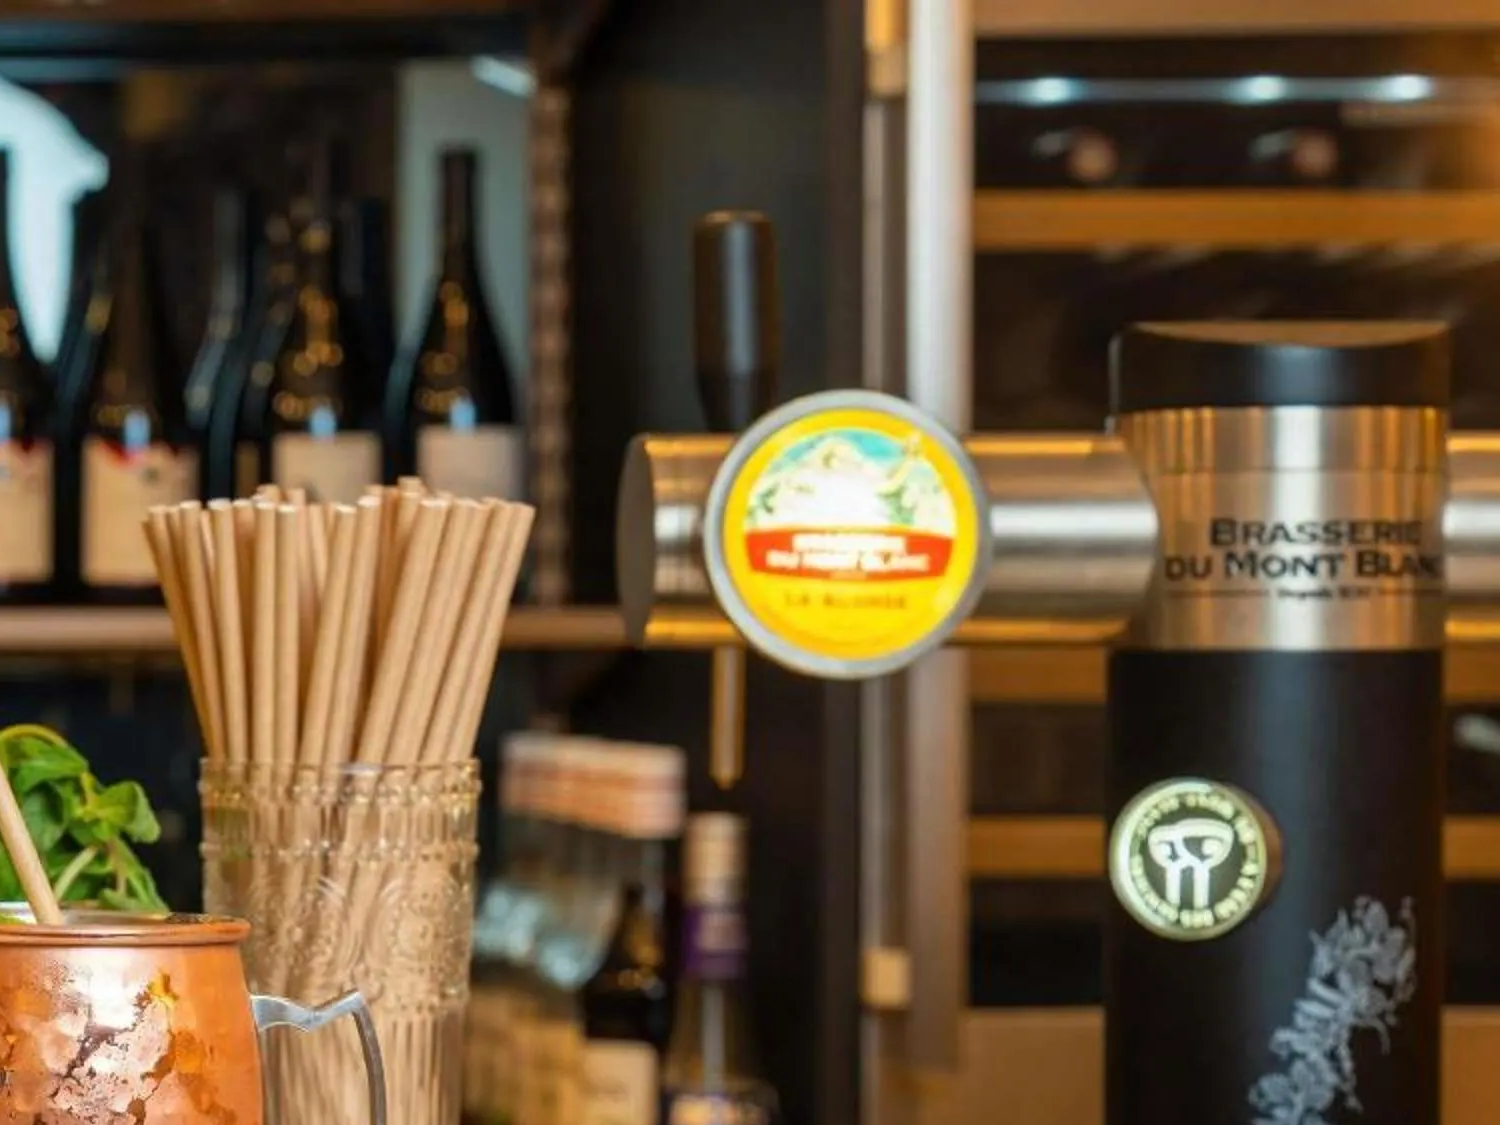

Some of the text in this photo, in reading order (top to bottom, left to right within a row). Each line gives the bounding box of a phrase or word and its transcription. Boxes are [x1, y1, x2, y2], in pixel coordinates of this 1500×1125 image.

[1211, 518, 1422, 547] BRASSERIE
[1164, 551, 1443, 582] DU MONT BLAN
